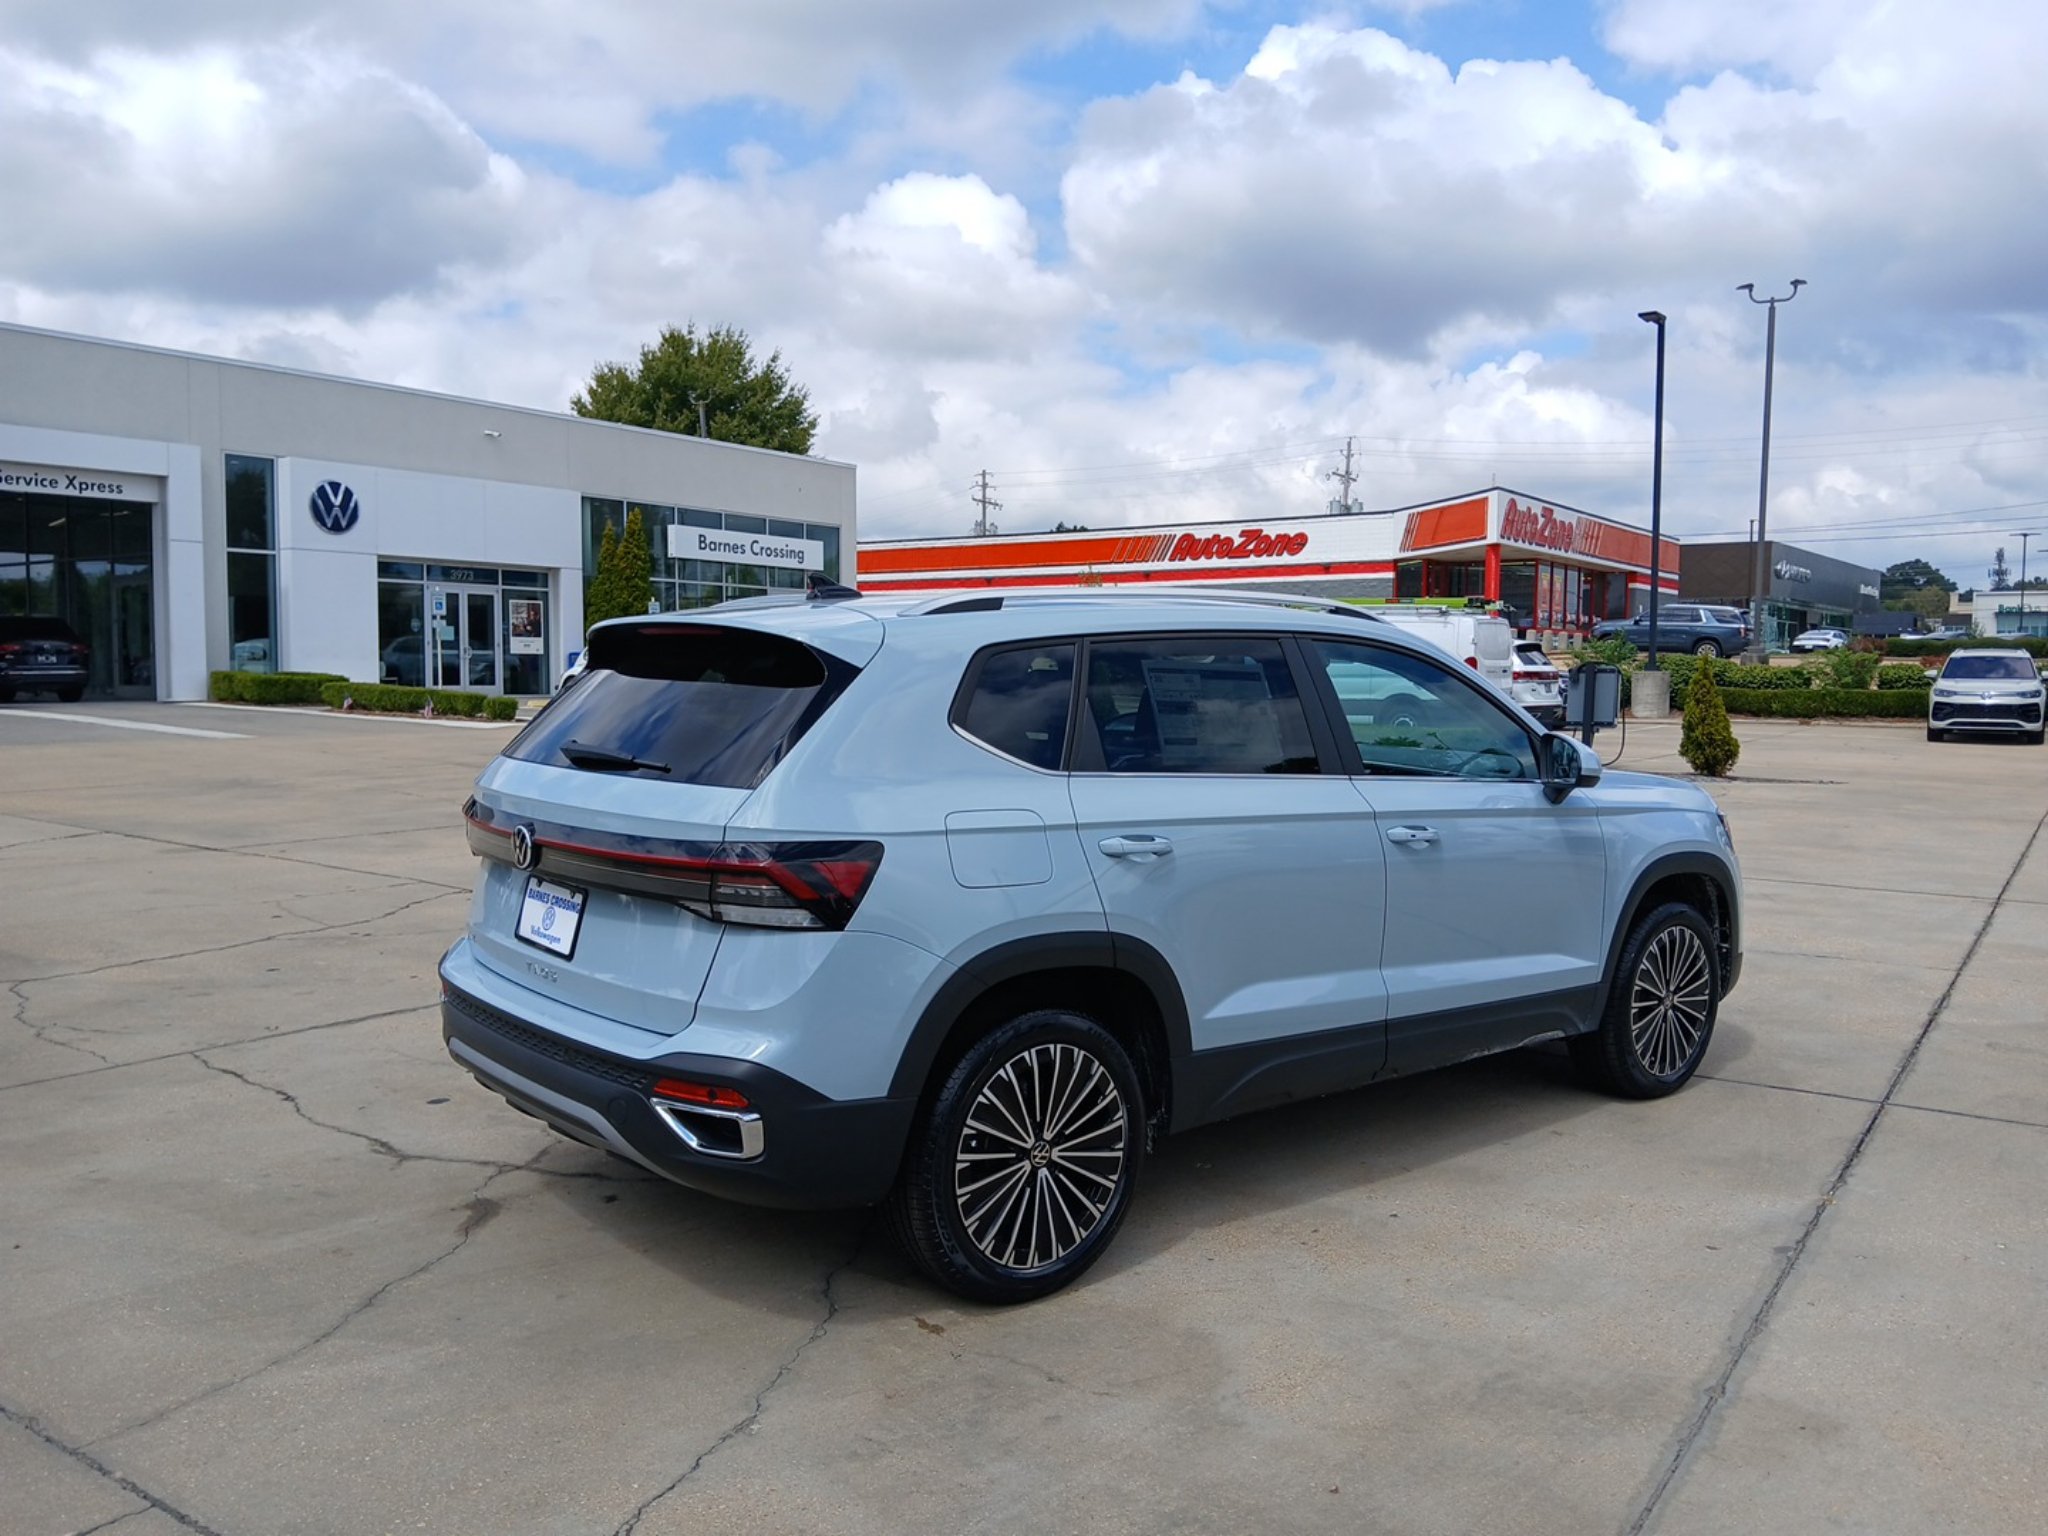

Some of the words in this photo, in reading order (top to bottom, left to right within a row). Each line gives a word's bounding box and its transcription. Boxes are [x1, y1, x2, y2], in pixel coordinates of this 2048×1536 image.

[65, 474, 124, 495] Xpress
[1500, 497, 1574, 554] AutoZone
[697, 534, 746, 555] Barnes
[750, 539, 805, 563] Crossing
[1168, 528, 1309, 562] AutoZone
[450, 569, 474, 581] 3973
[527, 888, 551, 905] BARNES
[550, 894, 582, 914] CROSSING
